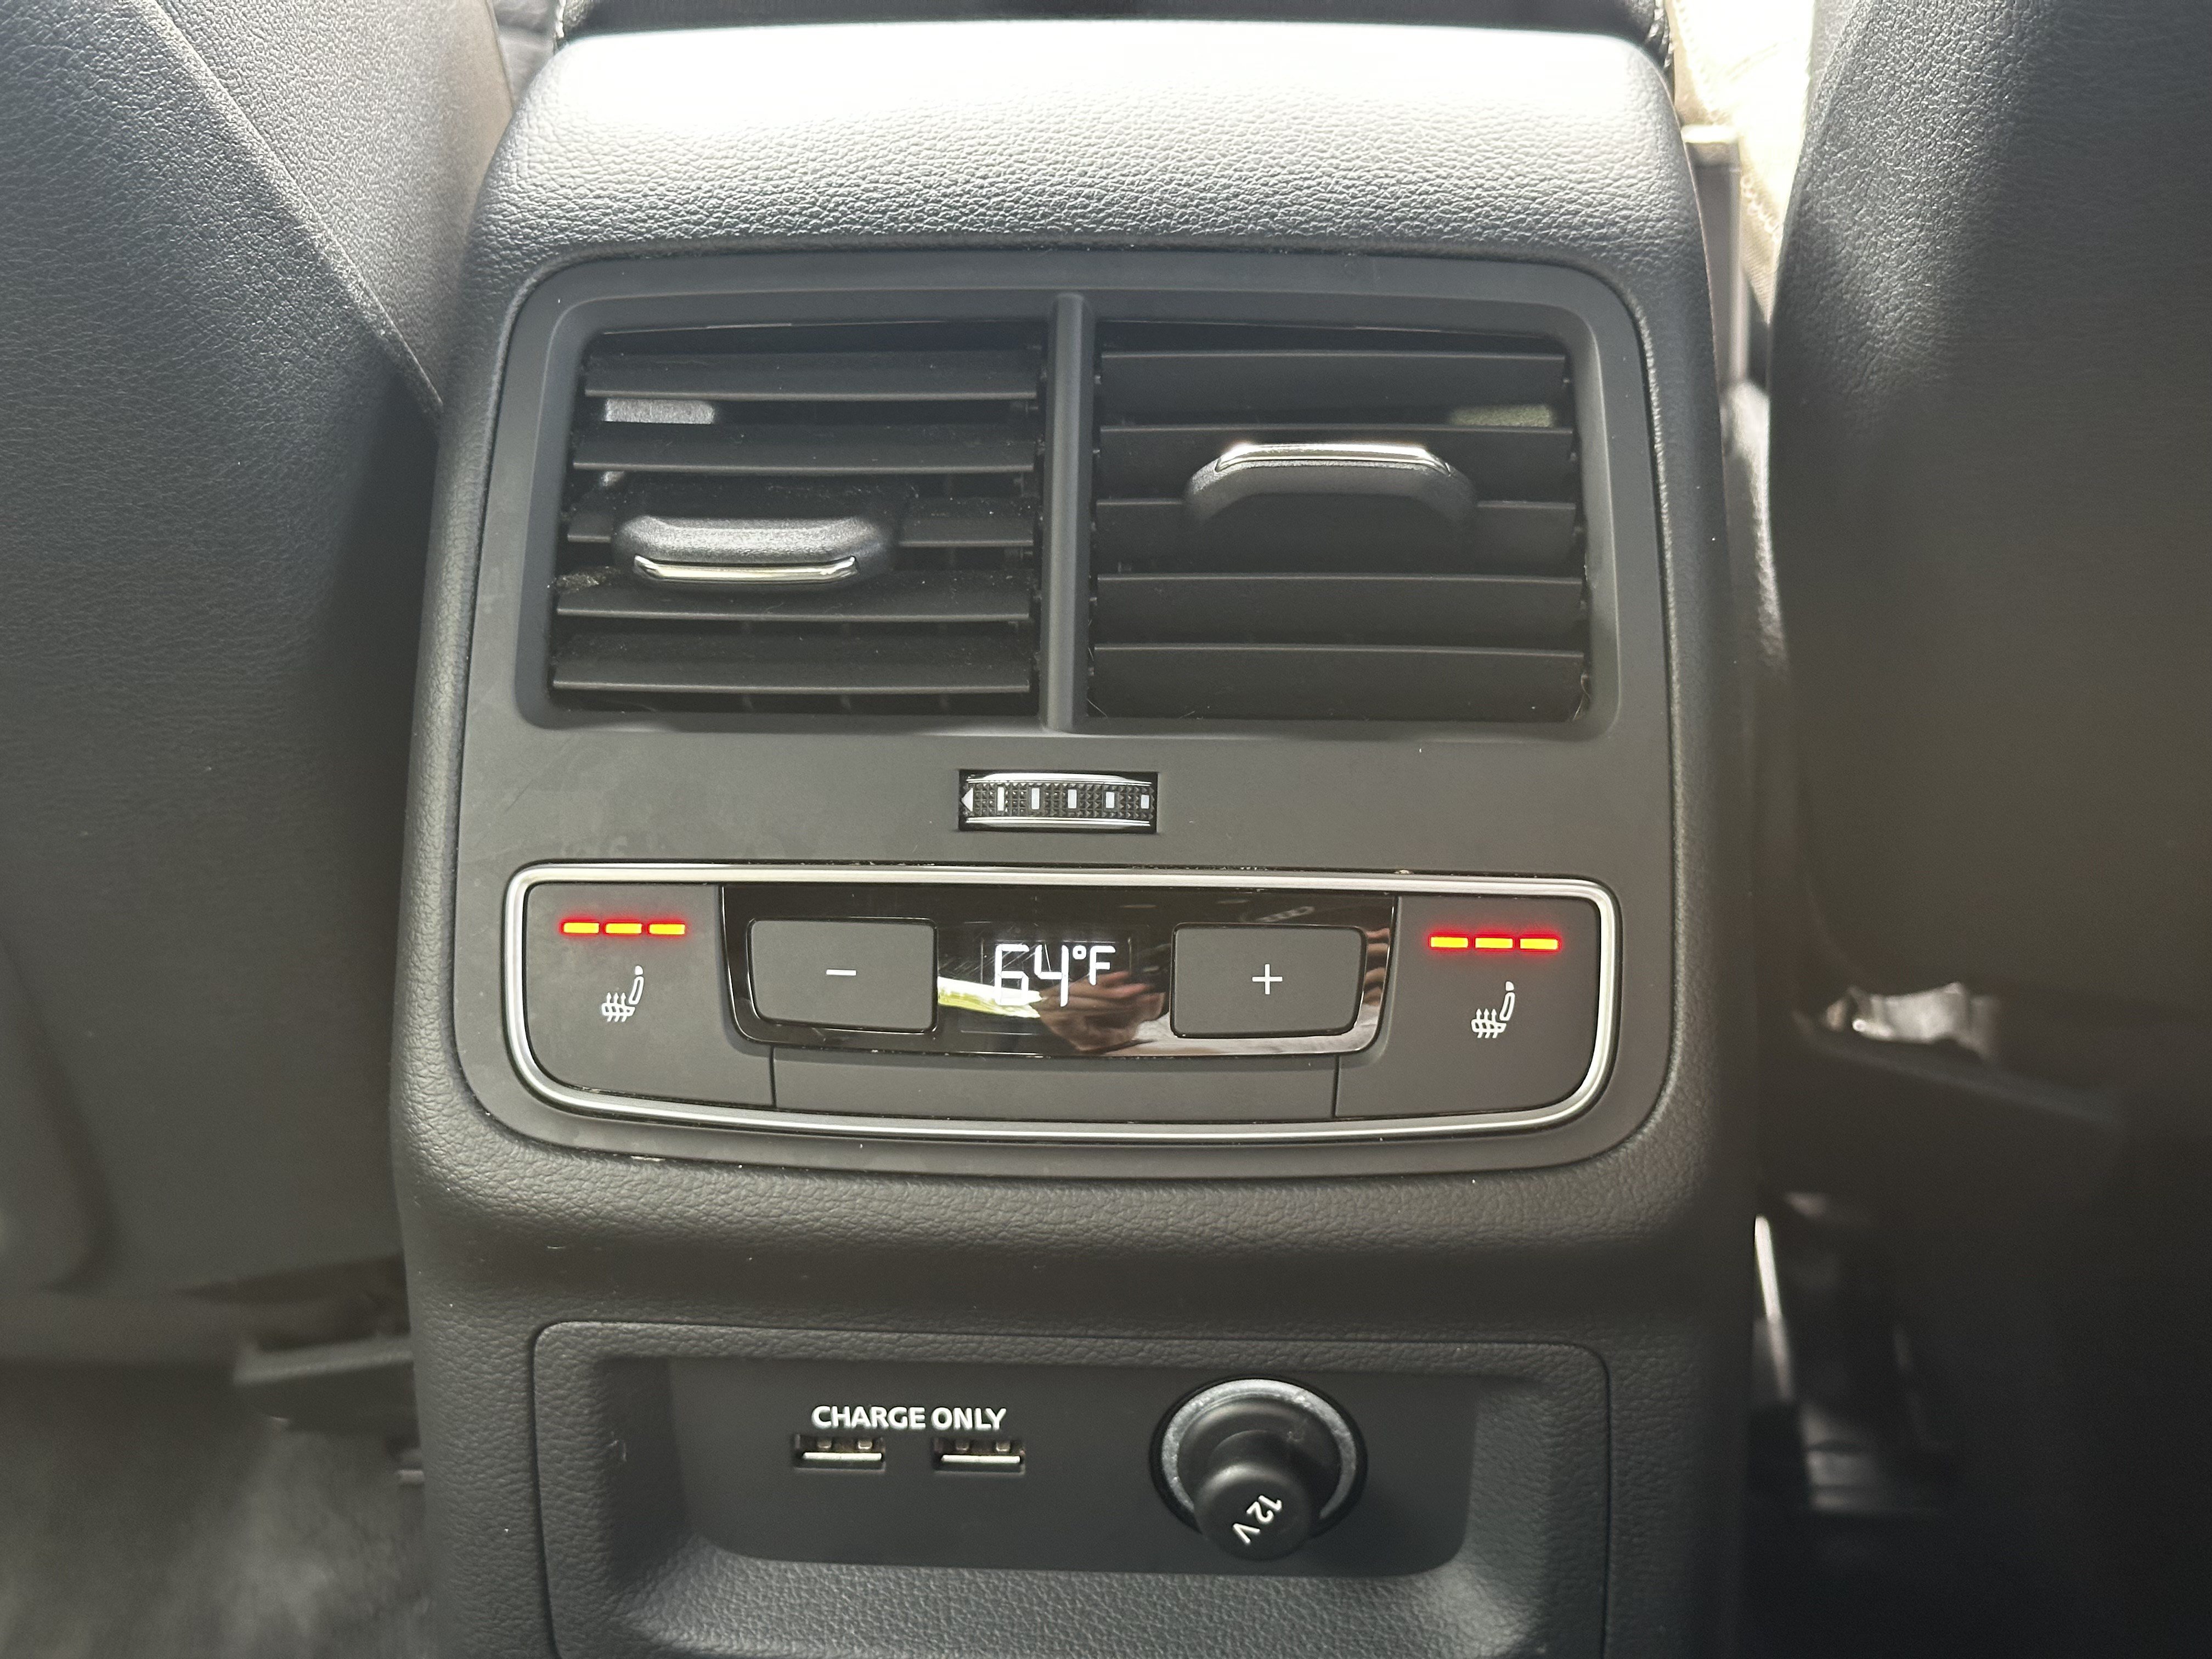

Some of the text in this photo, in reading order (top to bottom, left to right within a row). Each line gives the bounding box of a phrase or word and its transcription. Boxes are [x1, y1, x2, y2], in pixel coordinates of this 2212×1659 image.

[994, 944, 1116, 1007] 64°F
[811, 1405, 1007, 1430] CHARGE ONLY
